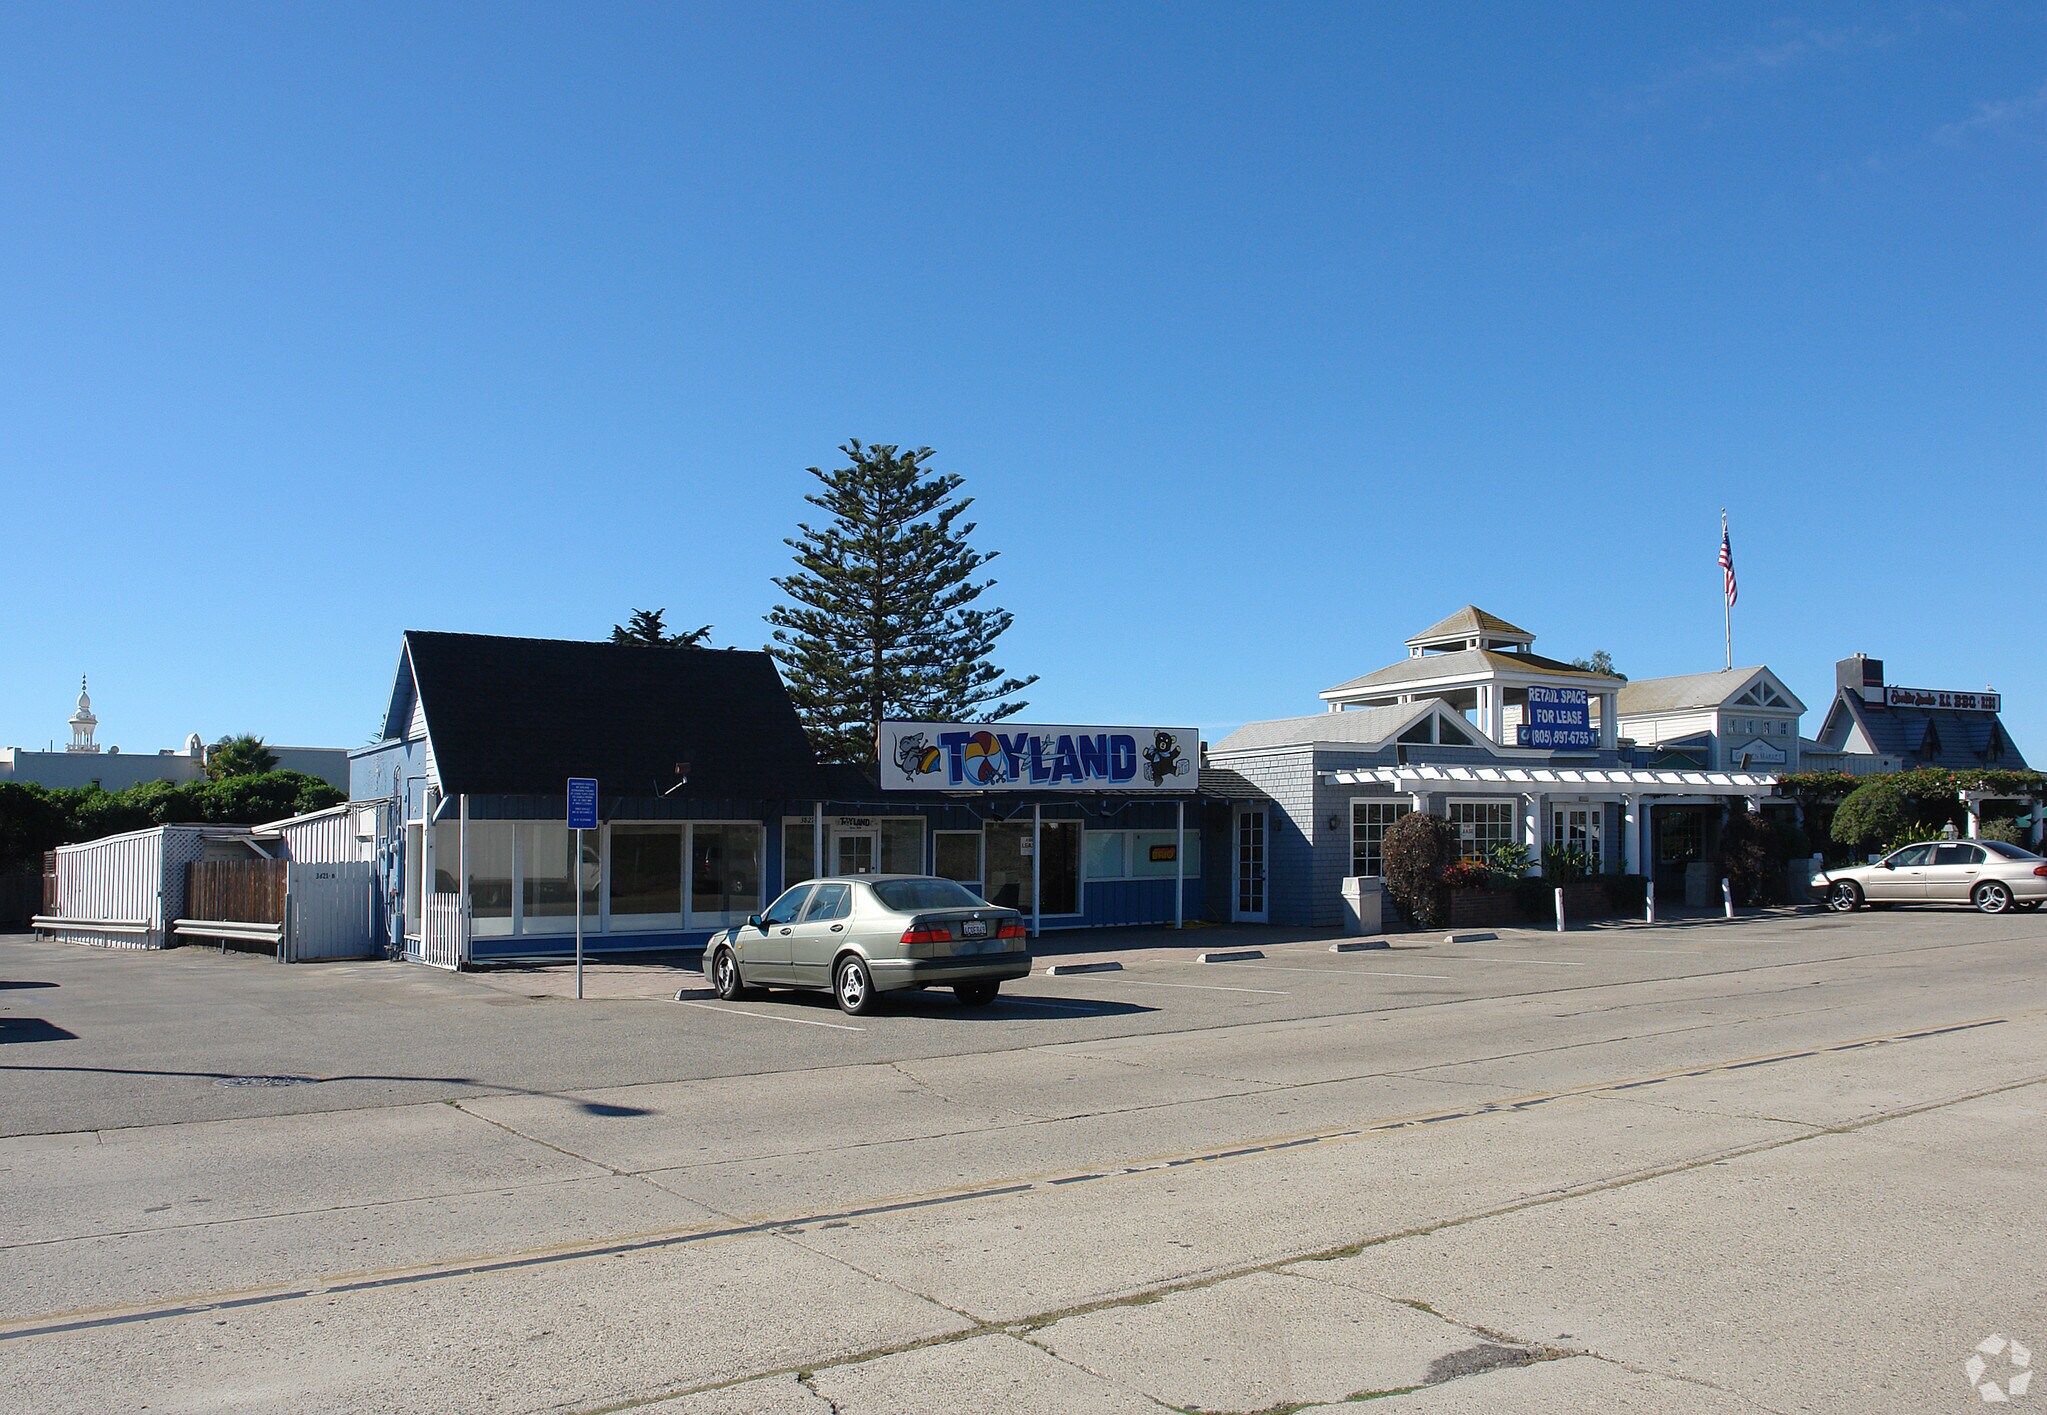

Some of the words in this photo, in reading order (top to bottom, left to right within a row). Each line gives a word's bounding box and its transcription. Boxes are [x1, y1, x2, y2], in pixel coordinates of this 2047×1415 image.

[1528, 688, 1559, 703] RETAIL
[1560, 690, 1586, 704] SPACE
[1537, 709, 1555, 723] FOR
[1556, 710, 1582, 724] LEASE
[1532, 730, 1552, 746] (805)
[1553, 731, 1589, 745] 897-6755
[938, 731, 1136, 785] TOYLAND
[840, 817, 870, 827] TOYLAND
